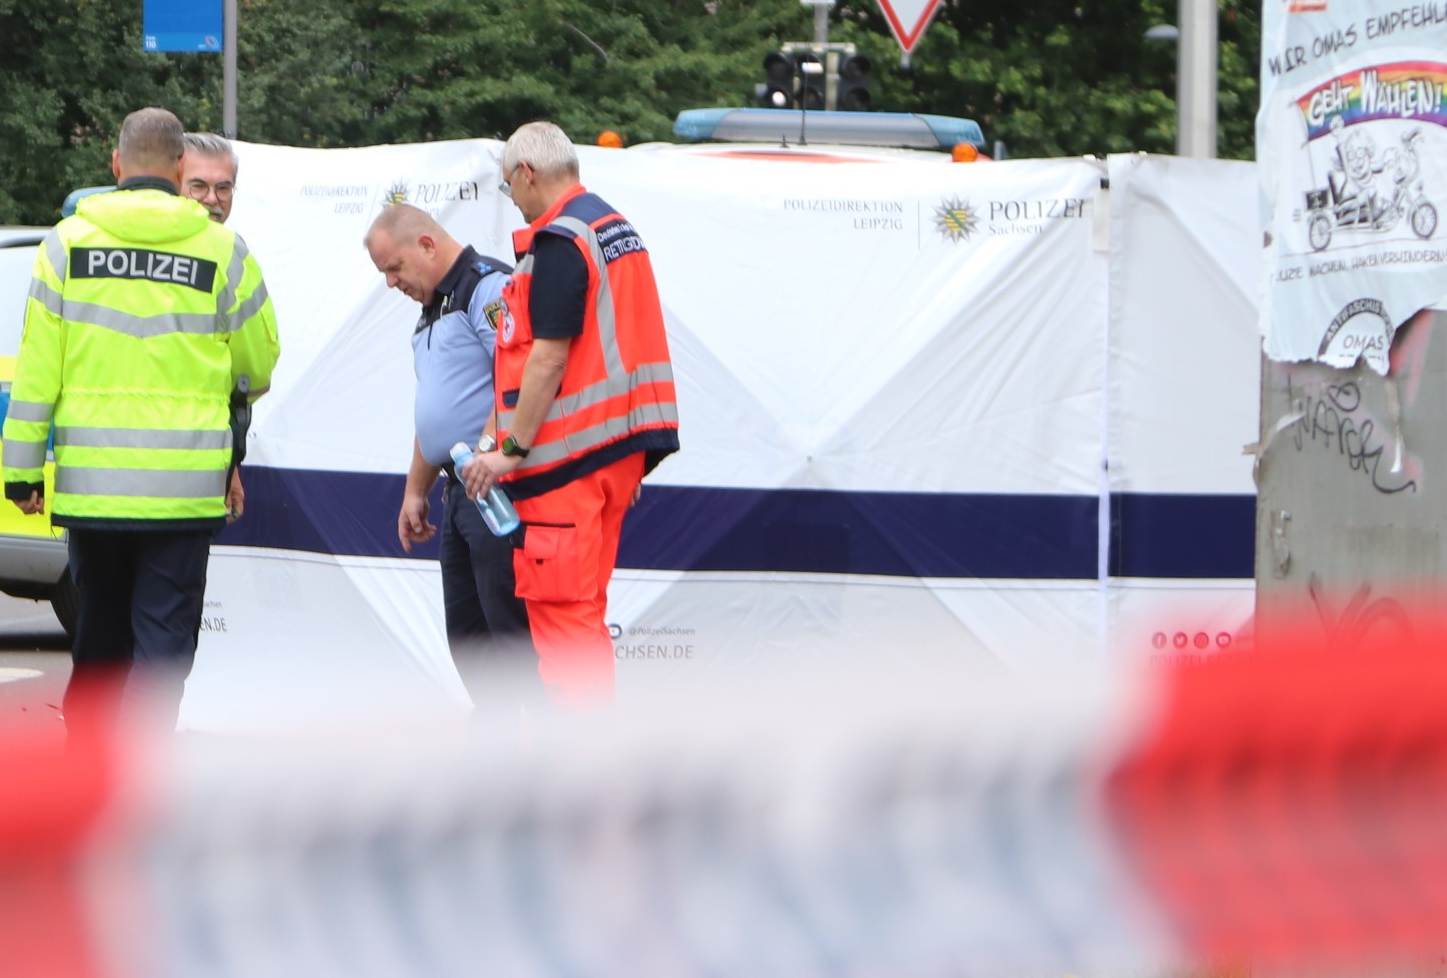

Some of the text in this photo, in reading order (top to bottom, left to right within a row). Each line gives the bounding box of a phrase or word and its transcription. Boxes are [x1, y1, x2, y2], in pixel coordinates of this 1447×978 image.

[1268, 46, 1307, 76] WIR
[1312, 23, 1358, 58] OMAS
[1366, 0, 1447, 40] EMPFEHL
[1308, 79, 1354, 127] GEHT
[415, 181, 479, 204] POLIZEI
[334, 202, 365, 215] LEIPZIG
[783, 198, 1085, 221] POLIZEIDIREKTION POLIZEI
[854, 218, 1043, 236] LEIPZIG Sachsen
[88, 249, 198, 285] POLIZEI
[1343, 334, 1384, 350] OMAS
[629, 626, 695, 636] @PolizeiSachsen
